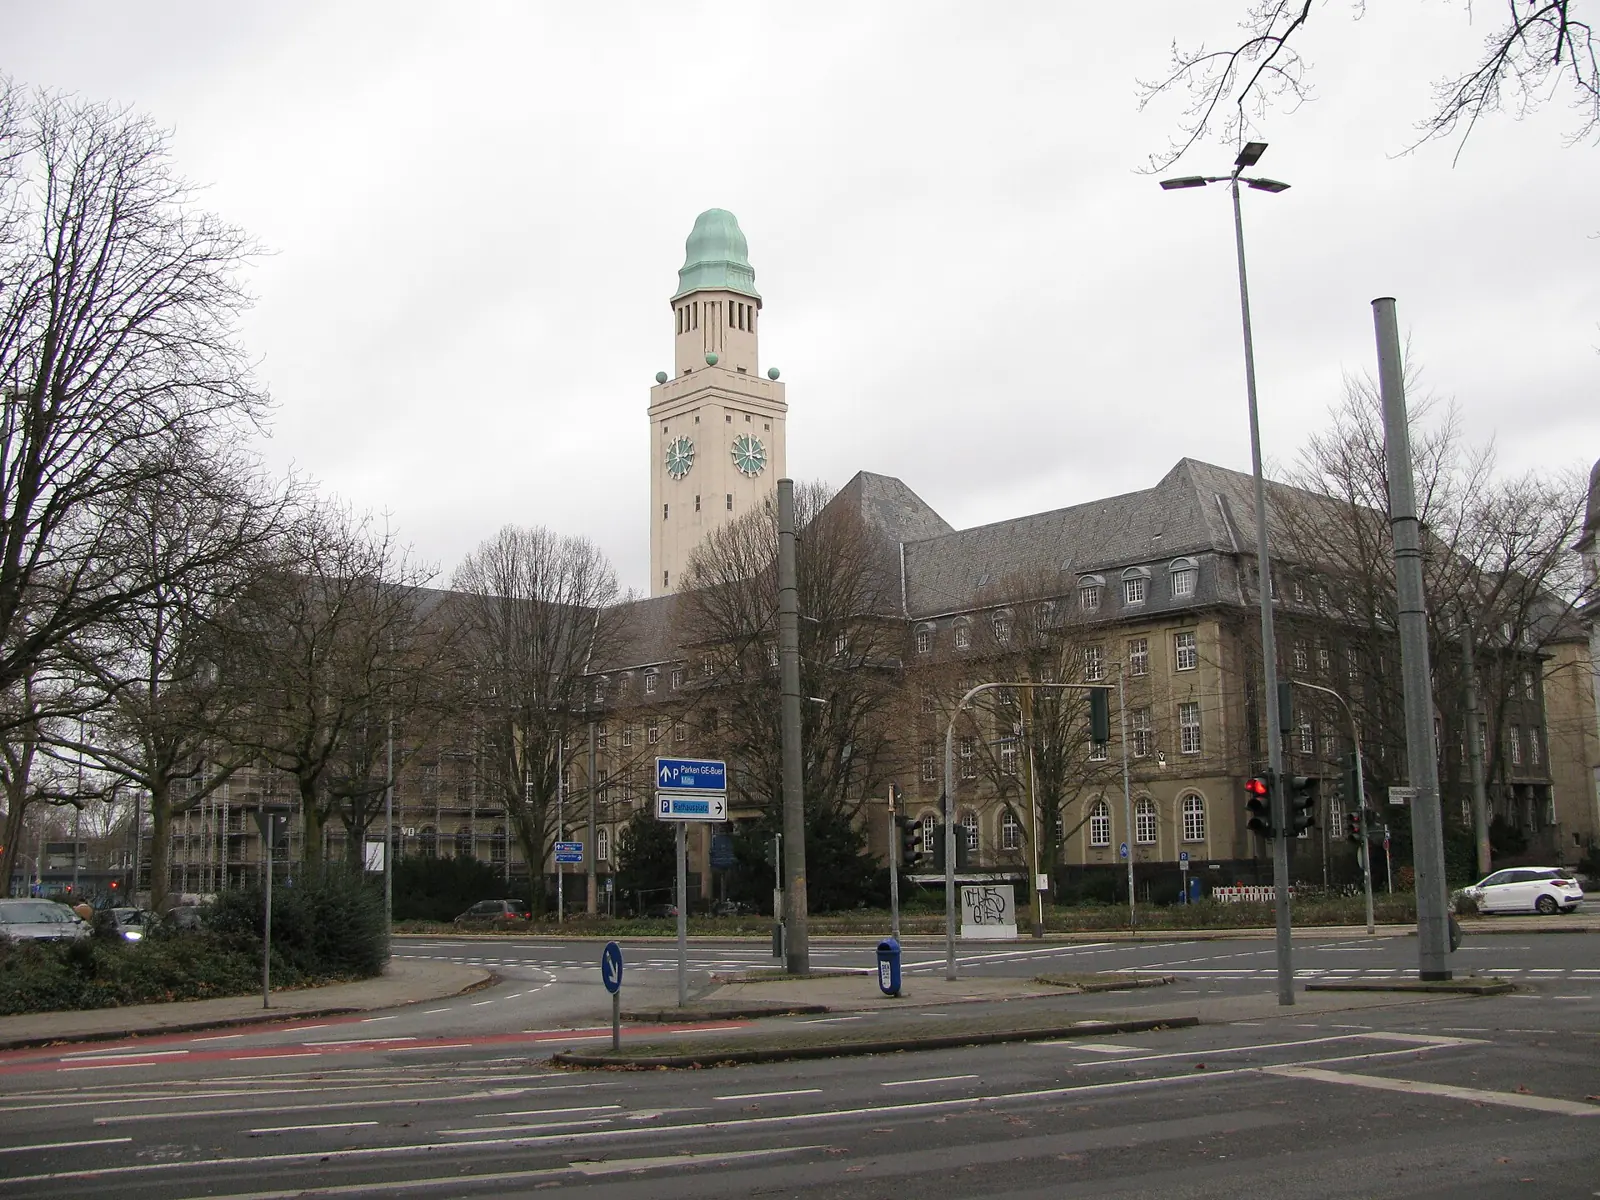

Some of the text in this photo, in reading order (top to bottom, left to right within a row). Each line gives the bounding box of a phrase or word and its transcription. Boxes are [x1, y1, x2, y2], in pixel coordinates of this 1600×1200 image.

[673, 768, 679, 780] P
[680, 765, 724, 775] Parken GE-Buer
[662, 801, 669, 812] P
